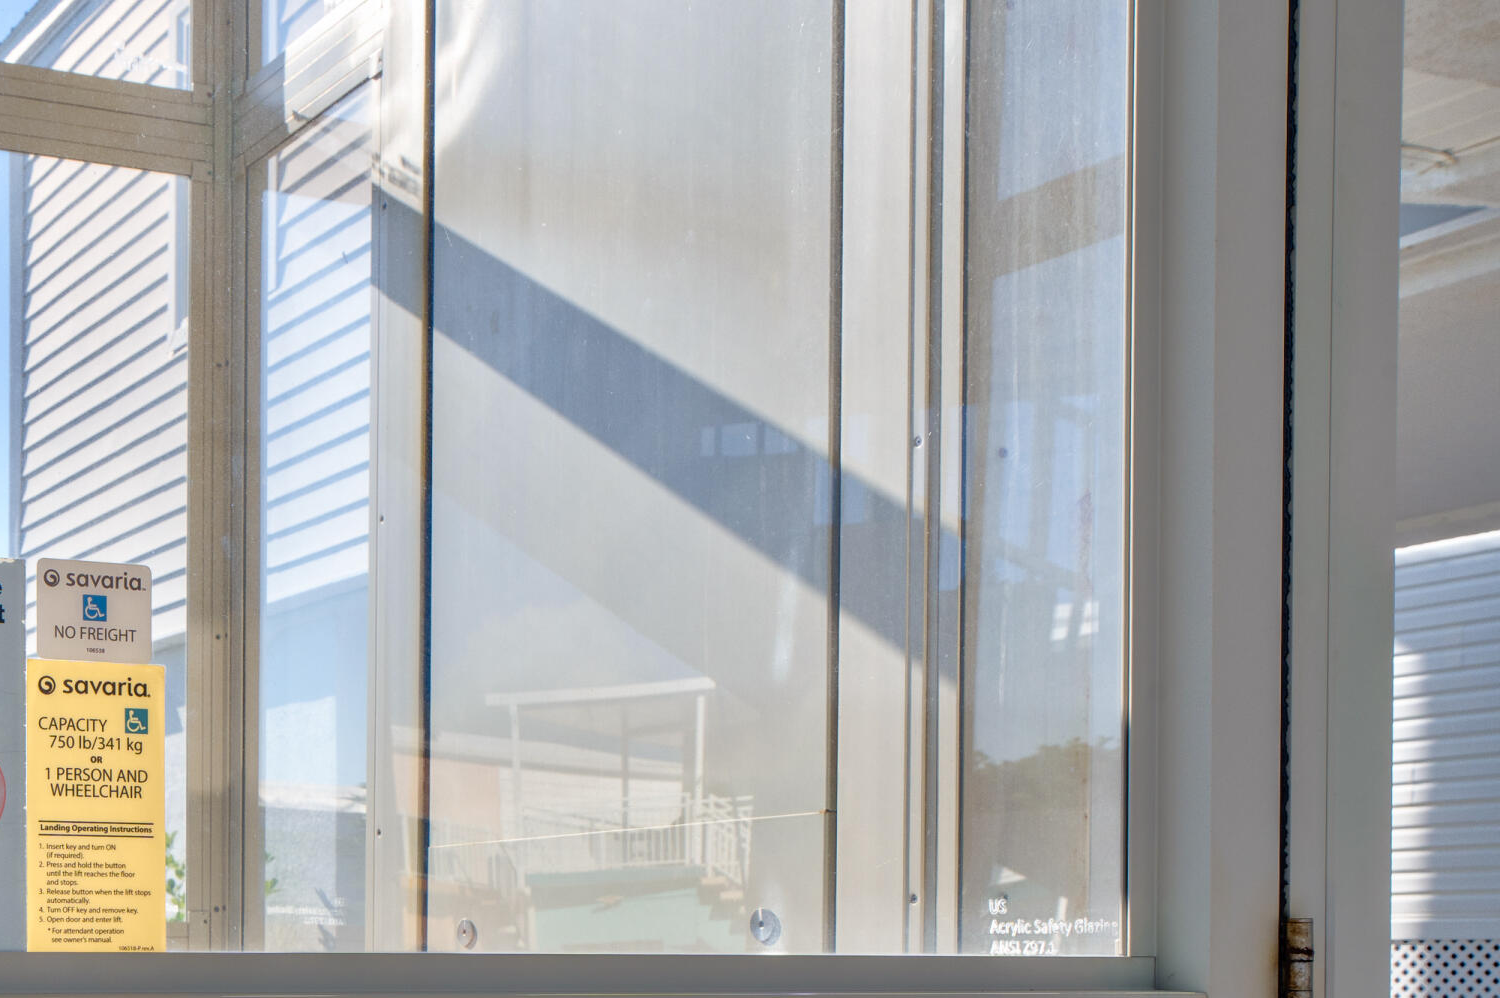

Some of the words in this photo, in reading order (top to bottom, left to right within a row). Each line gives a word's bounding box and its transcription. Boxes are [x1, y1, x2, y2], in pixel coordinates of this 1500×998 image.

[66, 572, 141, 591] savaria
[55, 625, 76, 639] NO
[80, 627, 136, 642] FREIGHT
[63, 677, 148, 697] savaria
[38, 716, 107, 732] CAPACITY
[49, 735, 74, 748] 750
[79, 736, 120, 750] lb/341
[127, 738, 143, 754] kg
[46, 768, 50, 780] 1
[57, 768, 112, 782] PERSON
[117, 769, 148, 783] AND
[50, 783, 142, 799] WHEELCHAIR
[40, 824, 70, 832] Landing
[72, 825, 108, 833] Operating
[110, 825, 152, 833] Instructions
[989, 899, 1007, 914] US
[990, 918, 1031, 937] Acrylic
[1034, 918, 1072, 937] Safety
